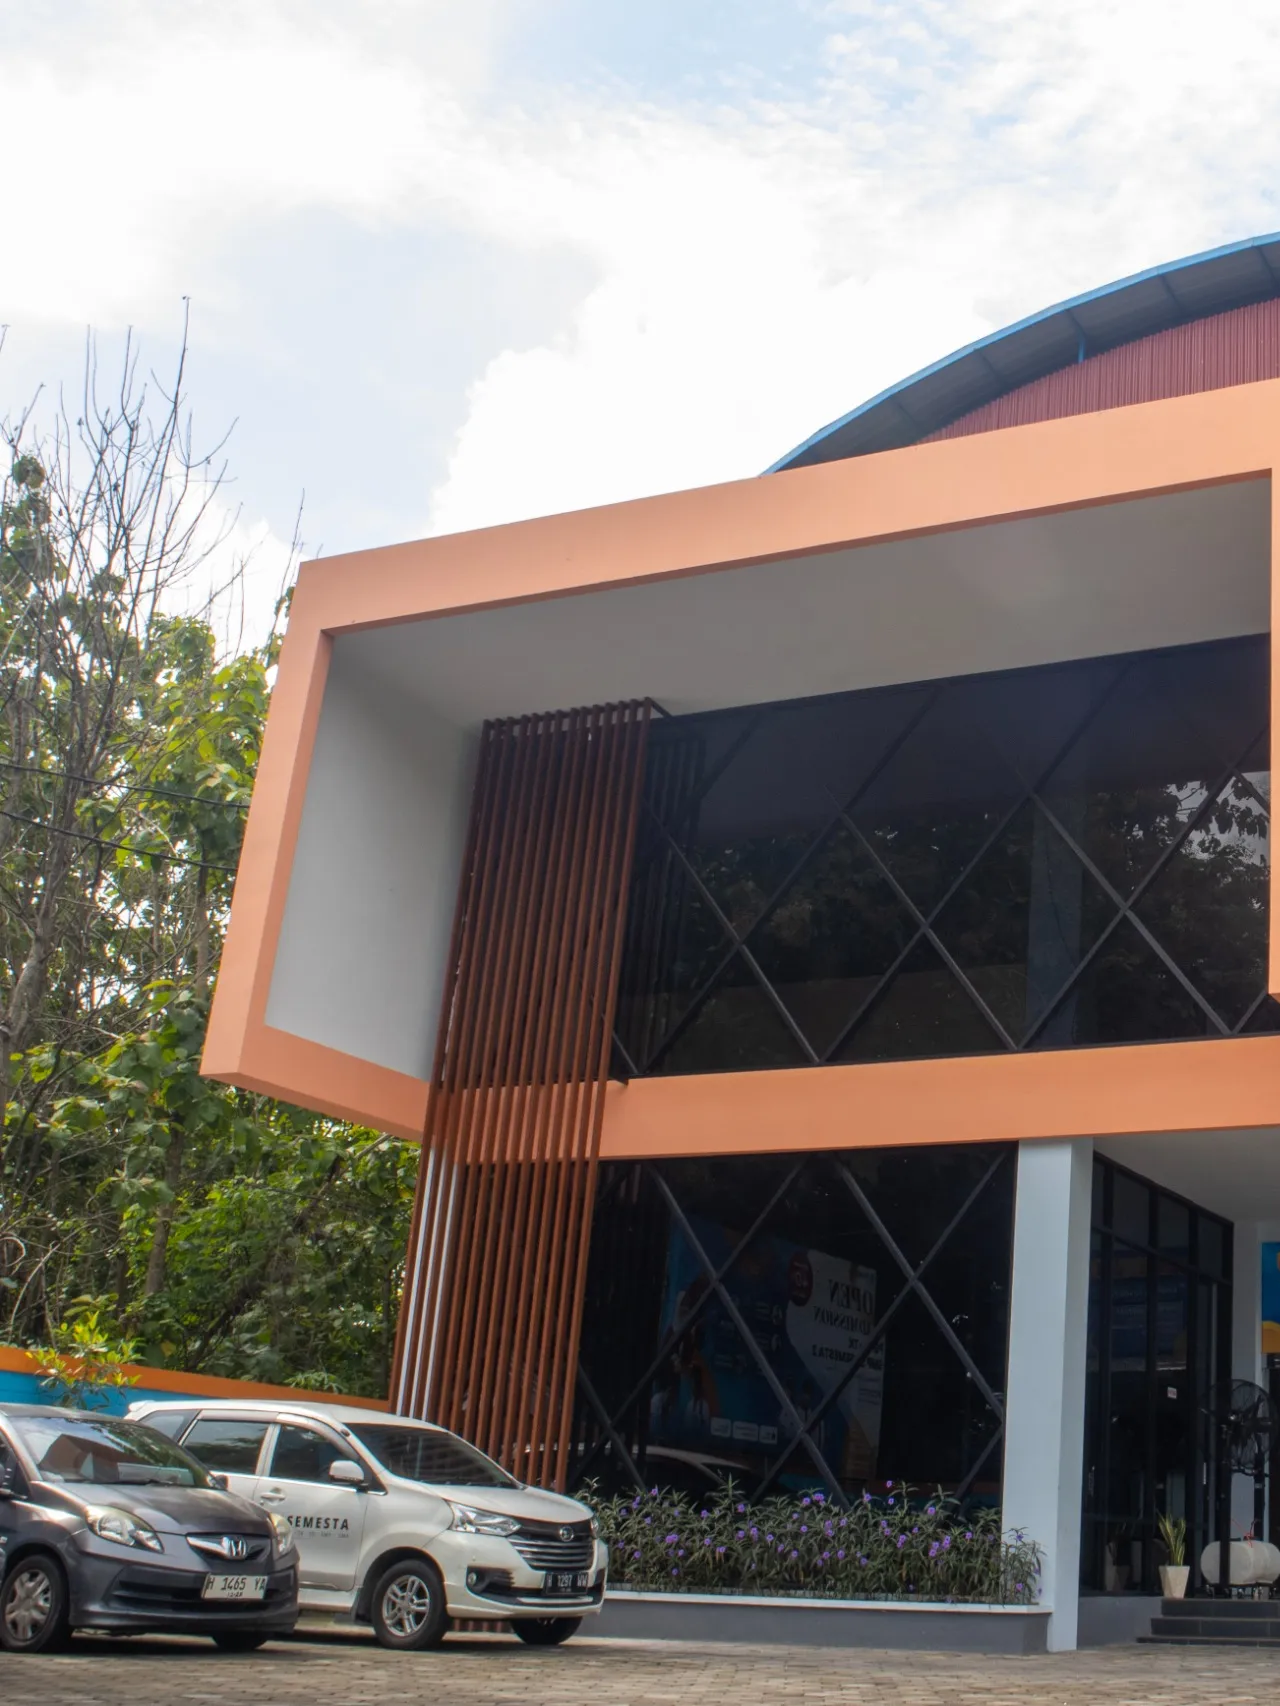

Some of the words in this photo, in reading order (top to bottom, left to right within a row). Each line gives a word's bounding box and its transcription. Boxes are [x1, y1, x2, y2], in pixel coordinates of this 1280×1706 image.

[287, 1515, 349, 1530] SEMESTA
[206, 1576, 215, 1590] H
[220, 1576, 247, 1590] 1465
[254, 1577, 266, 1591] YA
